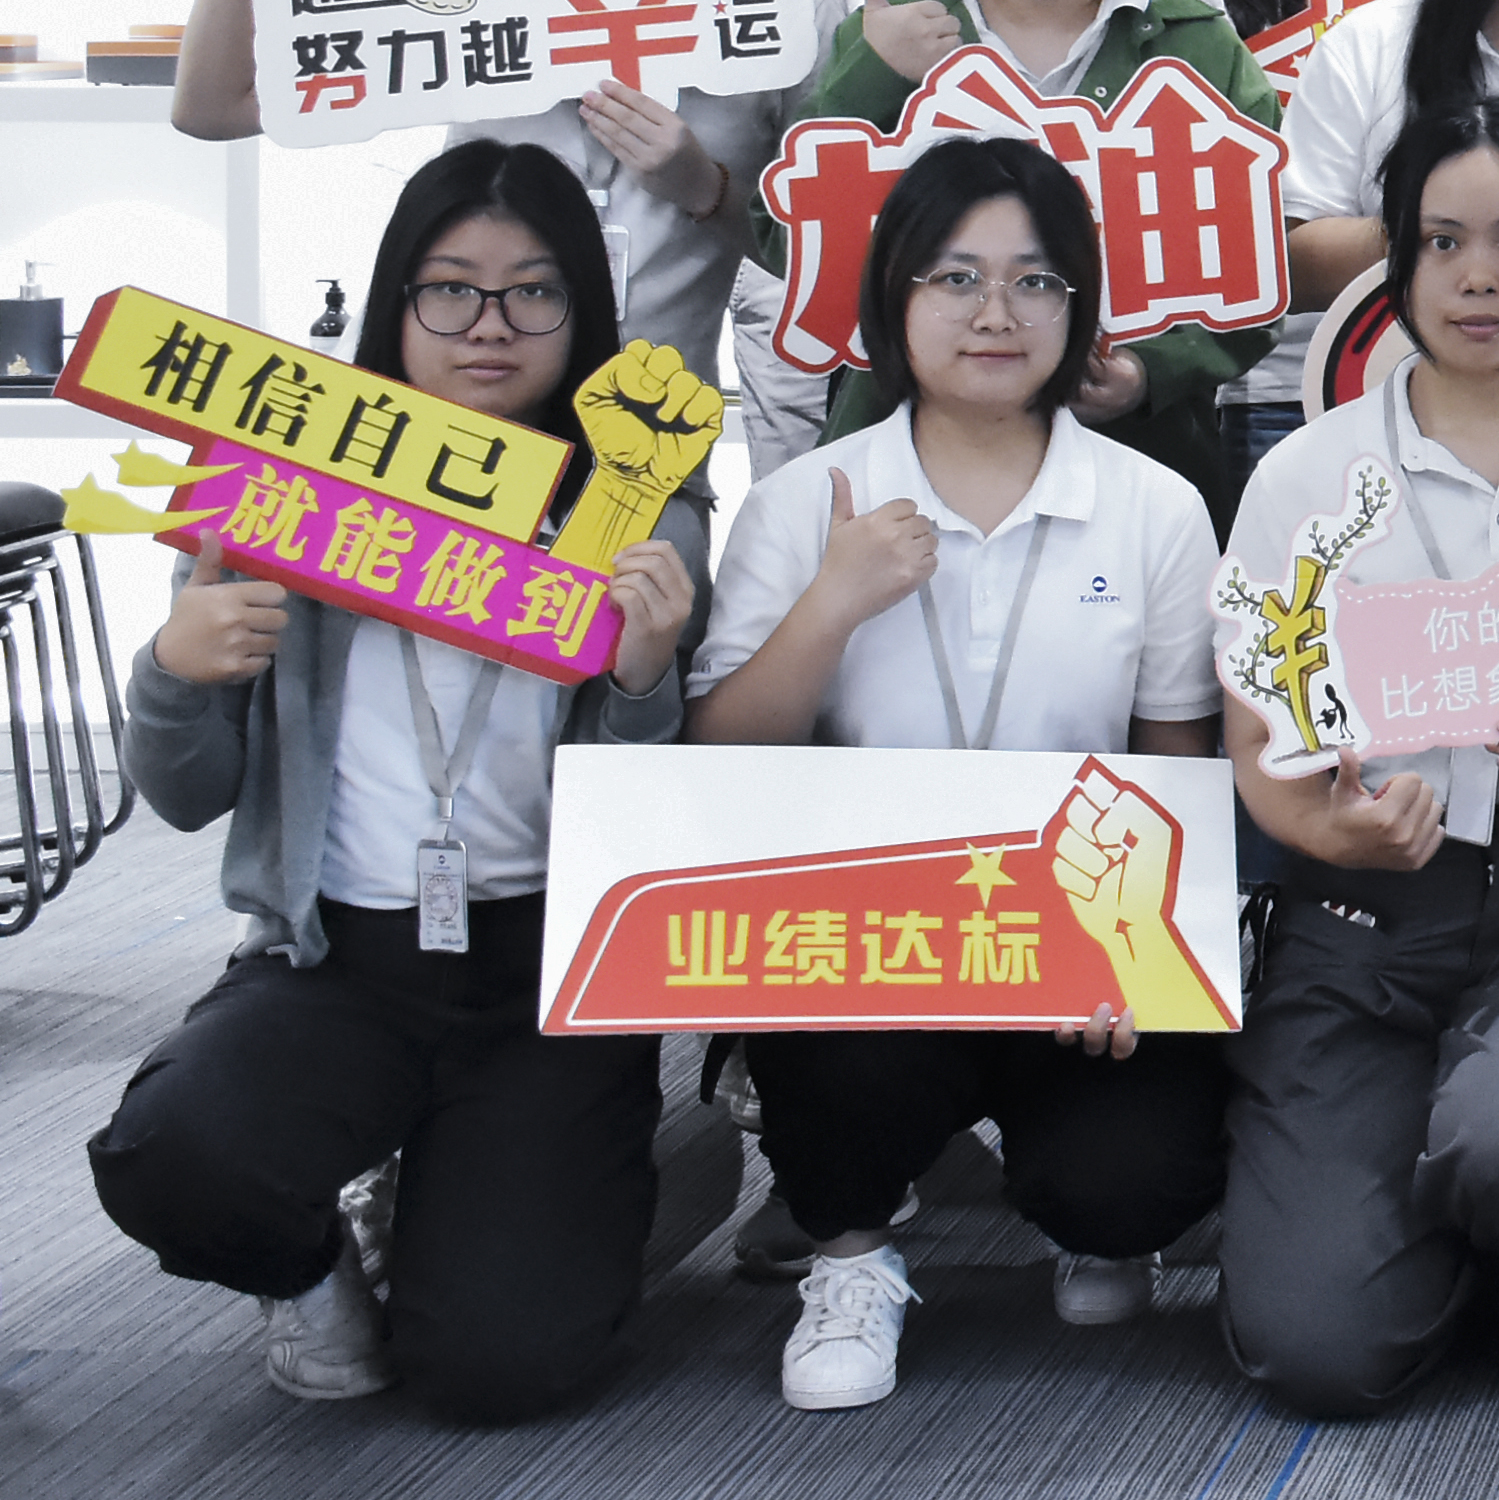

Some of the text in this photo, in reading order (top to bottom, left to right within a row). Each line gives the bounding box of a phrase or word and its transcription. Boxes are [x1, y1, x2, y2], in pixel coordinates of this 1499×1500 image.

[139, 318, 513, 511] 相信自己
[219, 462, 609, 658] 就能做到
[1079, 594, 1120, 604] EASTON
[664, 909, 1041, 987] 业绩达标
